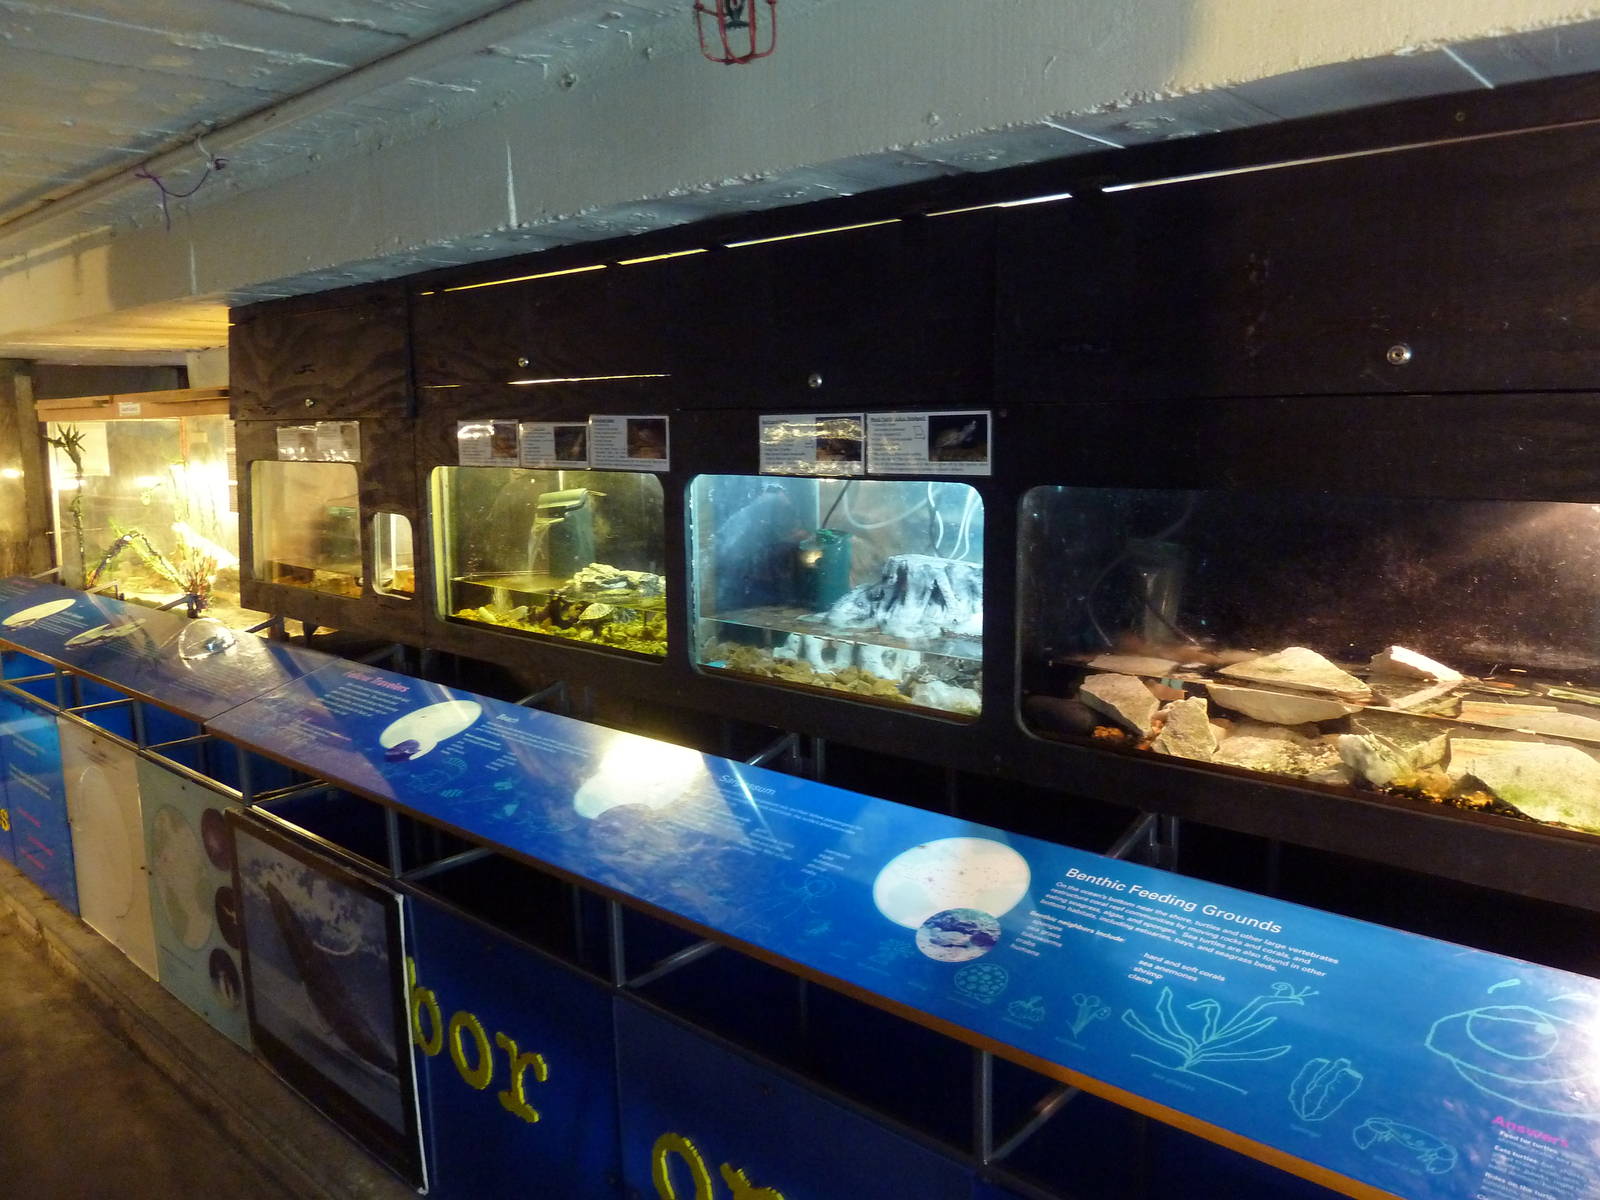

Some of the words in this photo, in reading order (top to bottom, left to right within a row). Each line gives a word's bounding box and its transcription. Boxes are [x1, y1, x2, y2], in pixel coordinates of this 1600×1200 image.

[719, 774, 776, 796] Sargssum
[1065, 867, 1126, 892] Benthic
[1128, 883, 1197, 913] Feeding
[1201, 904, 1283, 934] Grounds
[1029, 909, 1057, 922] Benthic
[1057, 920, 1095, 933] neighbors
[1094, 930, 1126, 943] include:
[1040, 899, 1067, 910] bottom
[1066, 907, 1098, 920] habitats,
[1099, 916, 1136, 931] including
[1134, 928, 1172, 941] estuaries,
[1173, 938, 1195, 948] bays,
[1215, 951, 1252, 964] seagrass
[1253, 960, 1277, 972] beds.
[1045, 894, 1069, 904] eating
[1068, 901, 1101, 913] seagrass,
[1103, 911, 1126, 920] algae,
[1142, 922, 1177, 935] sponges.
[1198, 937, 1226, 948] turtles
[1242, 950, 1261, 958] also
[1262, 955, 1290, 966] found
[1301, 967, 1327, 976] other
[1051, 889, 1089, 902] restructure
[1088, 899, 1109, 907] coral
[1125, 910, 1175, 926] communities
[1187, 927, 1220, 939] moving
[1219, 936, 1243, 945] rocks
[1262, 948, 1291, 959] corals,
[1107, 897, 1135, 907] bottom
[1168, 914, 1193, 924] shore,
[1194, 921, 1221, 931] turtles
[1239, 934, 1263, 942] other
[1264, 939, 1287, 949] large
[1288, 947, 1339, 964] vertebrates
[1128, 974, 1153, 984] clams
[1133, 966, 1164, 979] shrimp
[1143, 953, 1164, 962] hard
[1181, 965, 1199, 973] soft
[1198, 971, 1226, 981] corals
[1153, 964, 1199, 982] anemones
[1492, 1116, 1568, 1148] Answers
